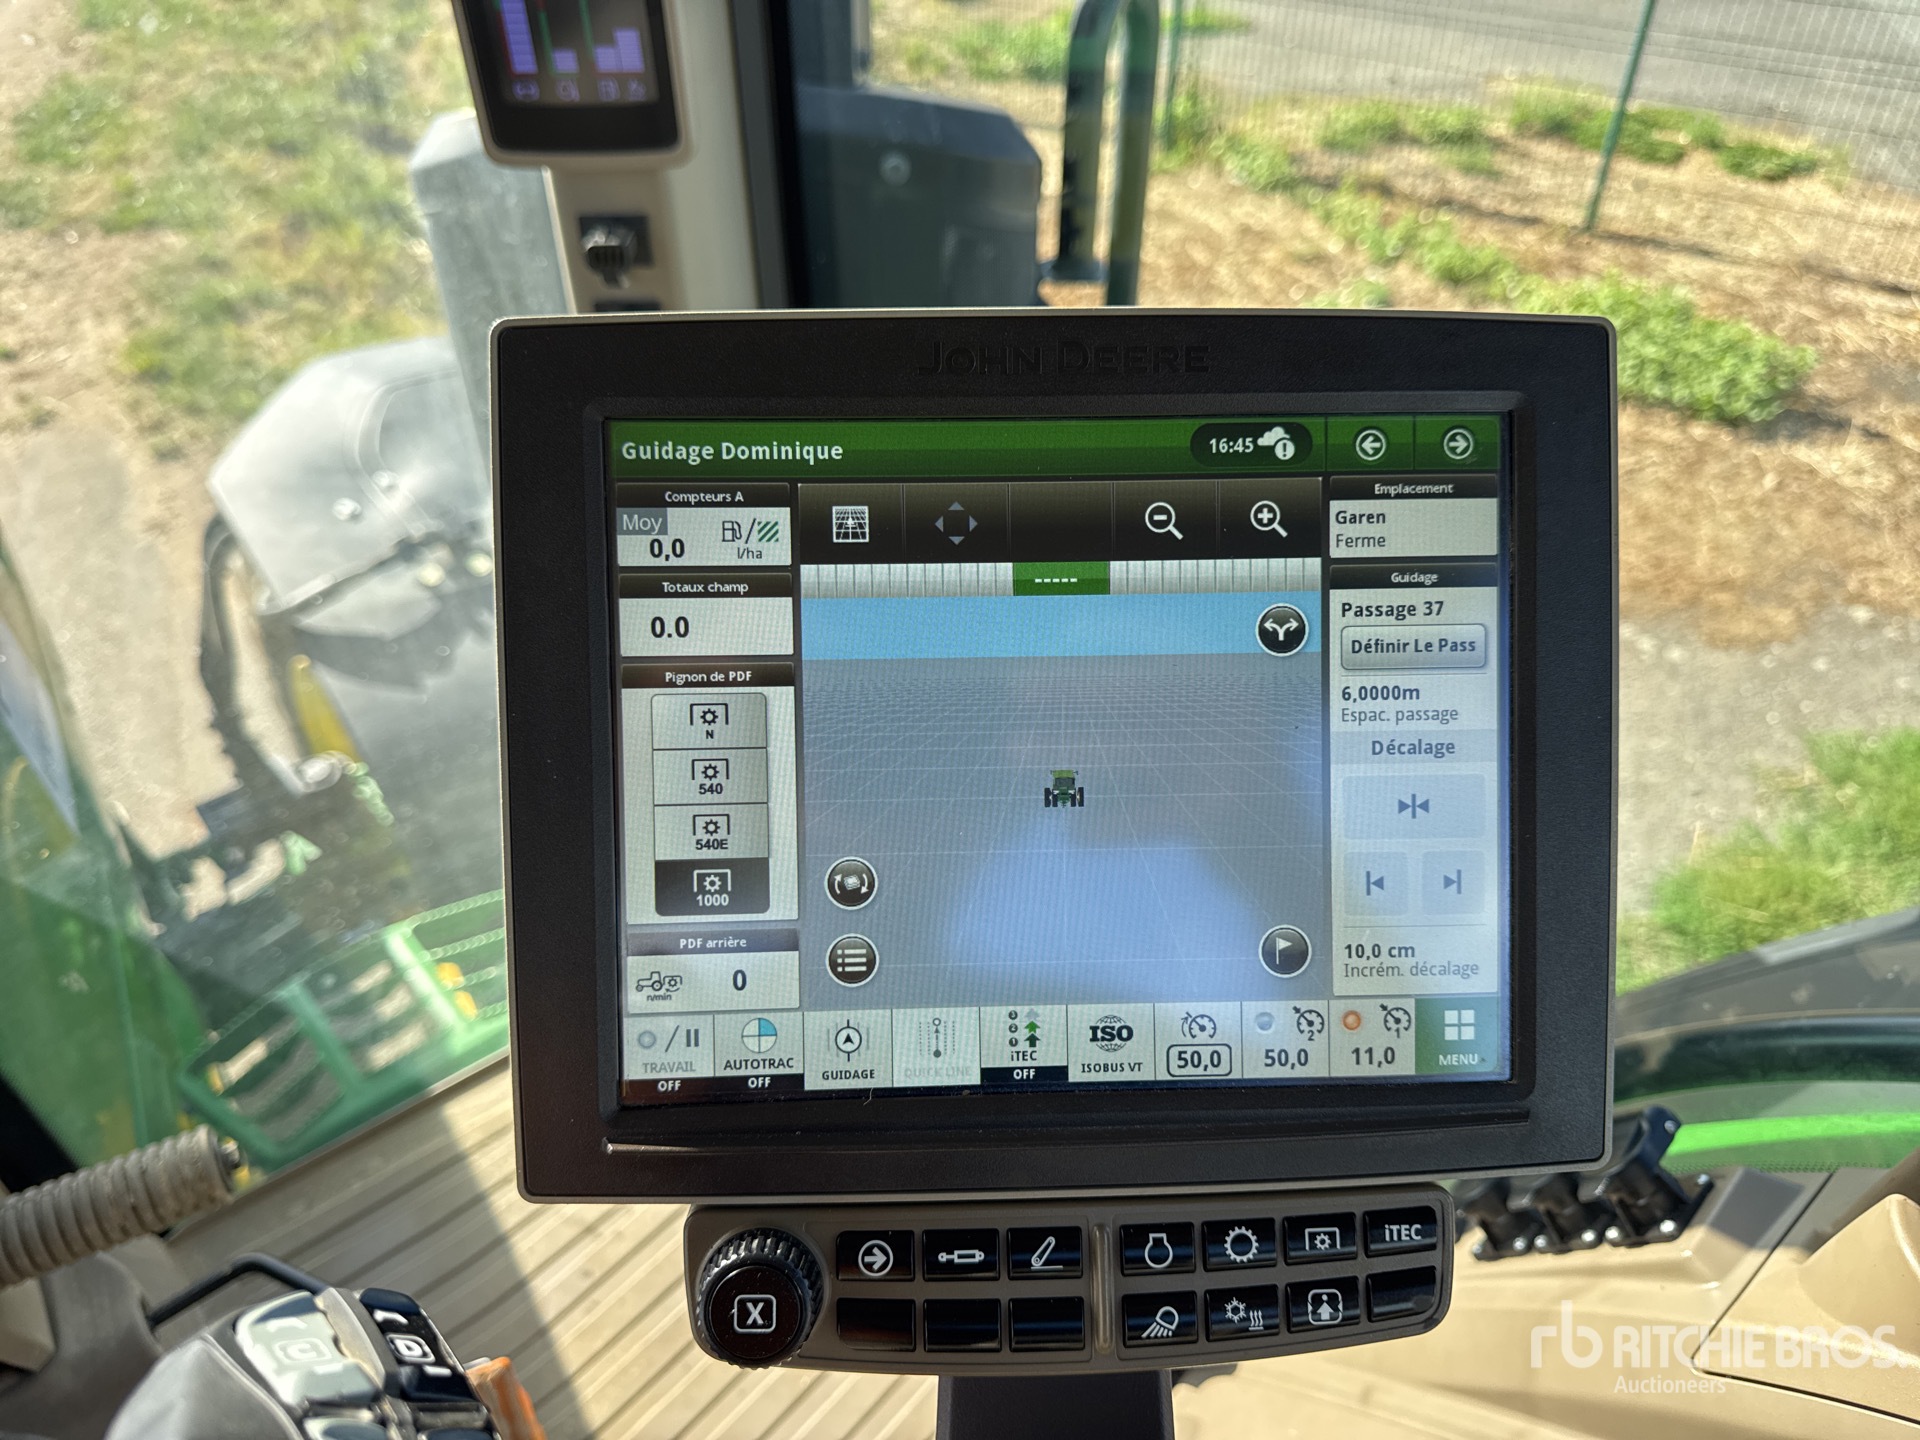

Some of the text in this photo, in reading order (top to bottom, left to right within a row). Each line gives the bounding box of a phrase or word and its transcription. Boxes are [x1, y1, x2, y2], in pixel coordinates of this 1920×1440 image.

[917, 339, 1211, 375] JOHN DEERE
[621, 441, 844, 465] Guidage Dominique
[1209, 437, 1254, 454] 16:45
[664, 490, 745, 504] Compteurs A
[1374, 483, 1454, 497] Emplacement
[622, 514, 662, 533] Moy
[1335, 511, 1386, 525] Garen
[1335, 533, 1386, 549] Ferme
[649, 538, 685, 561] 0,0
[736, 548, 763, 560] l/ha
[1390, 572, 1439, 585] Guidage
[662, 580, 749, 597] Totaux champ
[1341, 601, 1444, 620] Passage 37
[650, 616, 690, 638] 0.0
[1351, 638, 1476, 654] Définir Le Pass
[664, 670, 752, 687] Pignon de PDF
[1341, 685, 1420, 703] 6,0000m
[1341, 708, 1459, 725] Espac. passage
[705, 729, 714, 739] N
[1371, 739, 1456, 758] Décalage
[698, 783, 723, 795] 540
[695, 838, 728, 850] 540E
[696, 893, 729, 906] 1000
[679, 936, 747, 949] PDF arrière
[1344, 943, 1415, 960] 10,0 cm
[1344, 961, 1480, 979] Incrém. décalage
[732, 969, 748, 991] 0
[1089, 1025, 1133, 1042] ISO
[1307, 1030, 1315, 1041] 2
[1394, 1027, 1401, 1039] 1
[1010, 1050, 1037, 1061] iTEC
[1176, 1050, 1221, 1072] 50,0
[1264, 1048, 1308, 1070] 50,0
[1351, 1046, 1395, 1068] 11,0
[1438, 1053, 1478, 1066] MENU
[642, 1061, 696, 1073] TRAVAIL
[724, 1058, 794, 1071] AUTOTRAC
[1081, 1062, 1143, 1073] ISOBUS VT
[748, 1077, 771, 1088] OFF
[822, 1069, 876, 1081] GUIDAGE
[1013, 1069, 1036, 1080] OFF
[657, 1081, 681, 1091] OFF
[1384, 1224, 1422, 1242] iTEC
